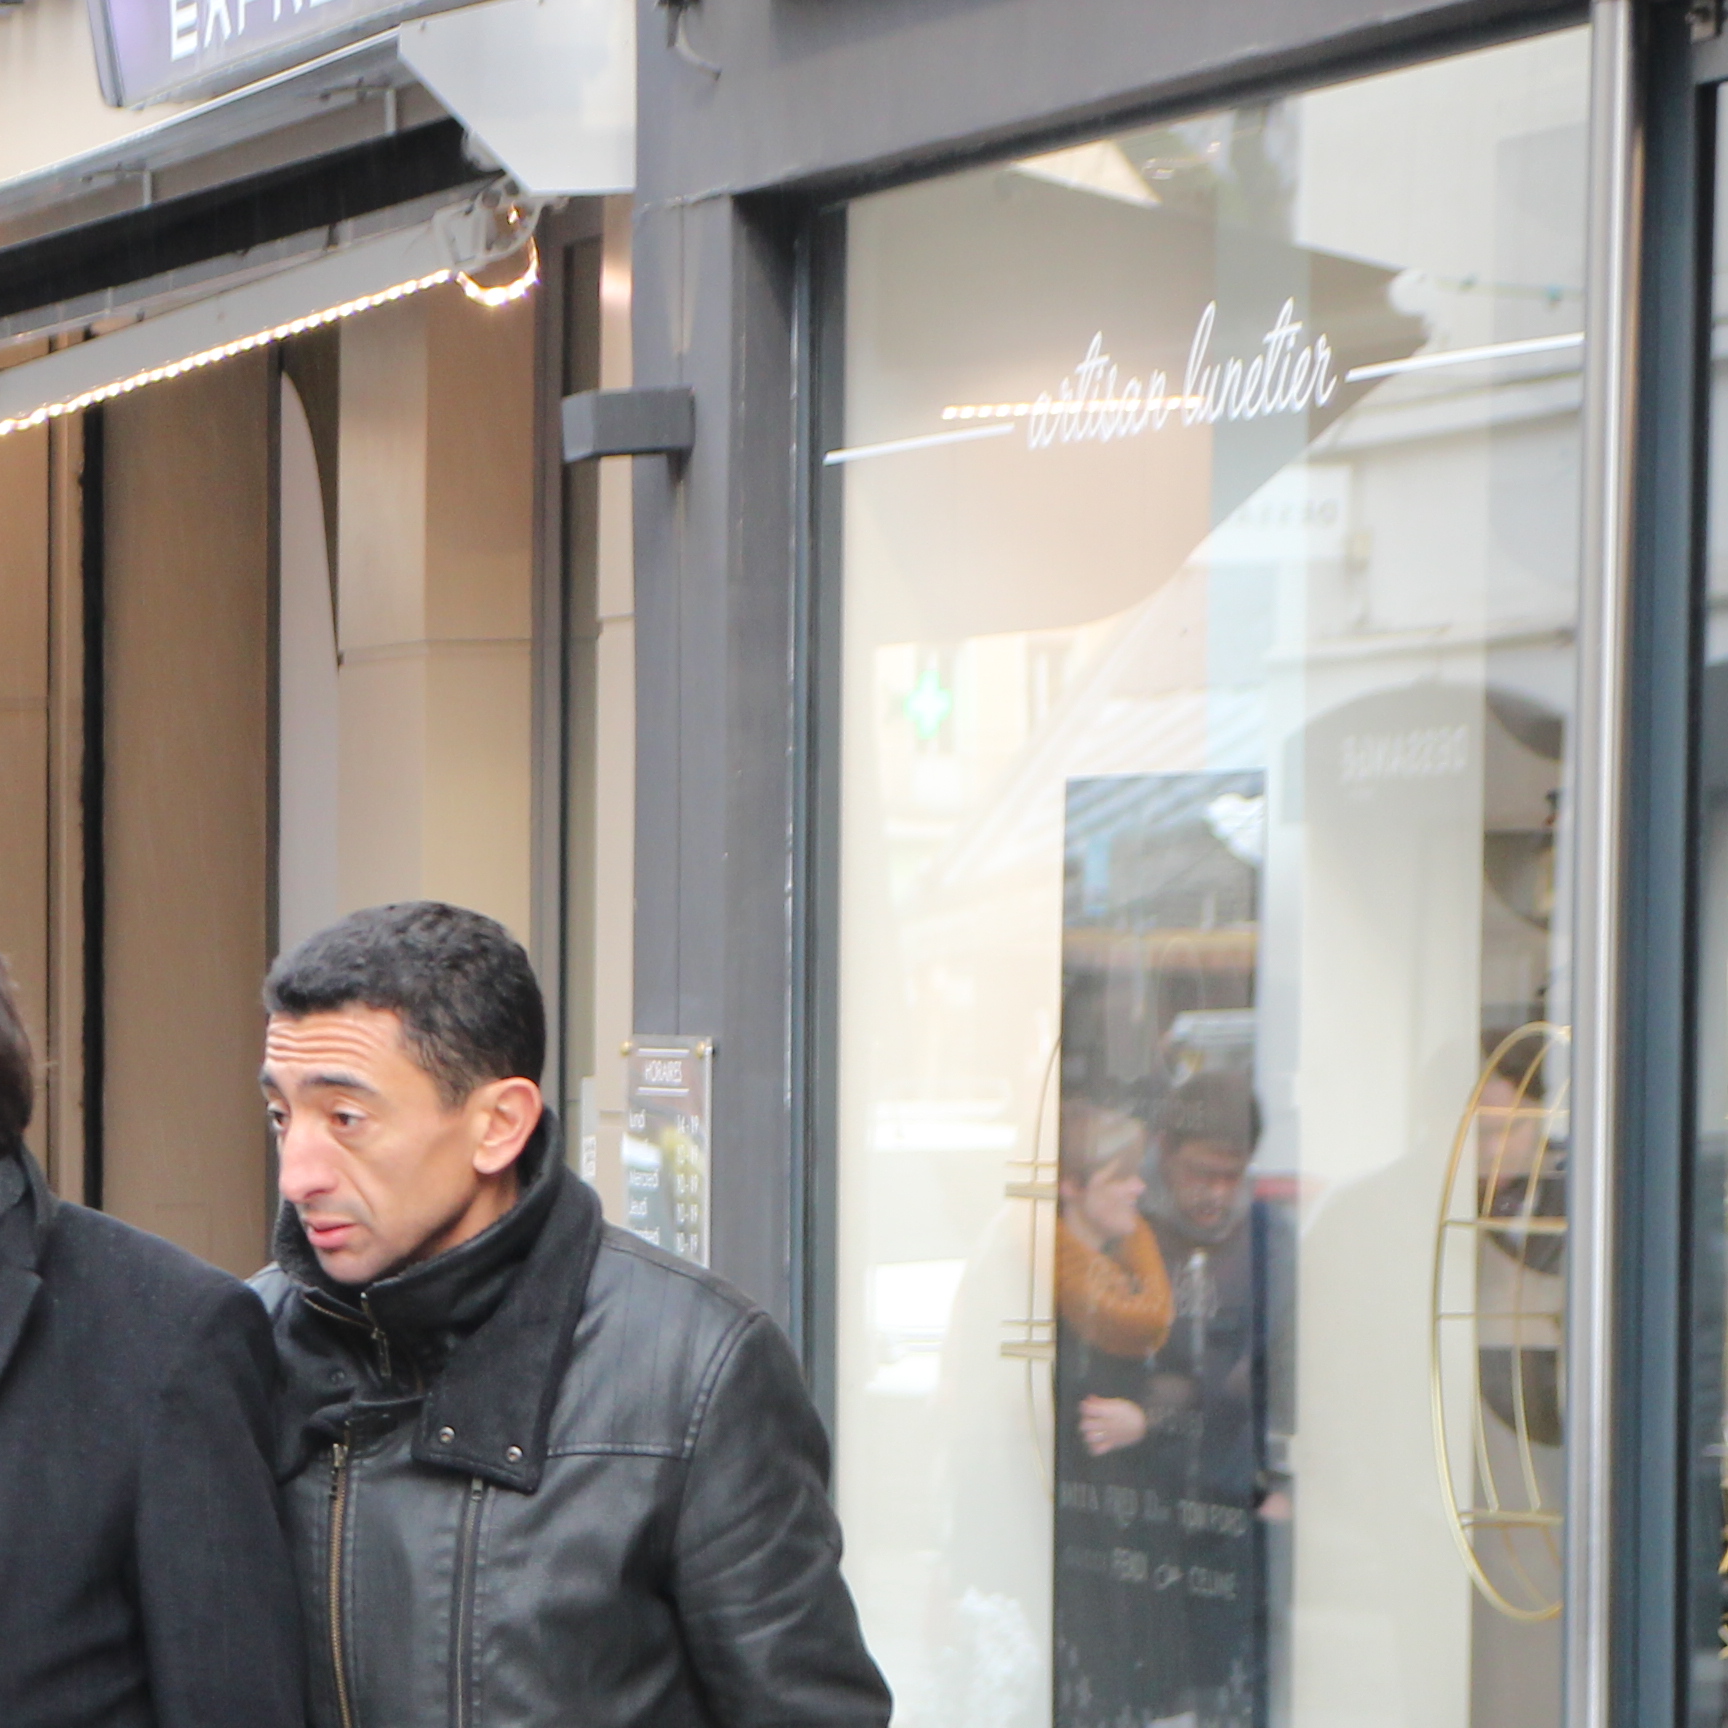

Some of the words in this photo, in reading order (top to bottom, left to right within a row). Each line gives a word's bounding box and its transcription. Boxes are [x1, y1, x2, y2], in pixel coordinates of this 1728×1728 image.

[1028, 330, 1168, 450] artisan
[1181, 296, 1338, 427] lunetier
[644, 1059, 683, 1084] HORAIRES
